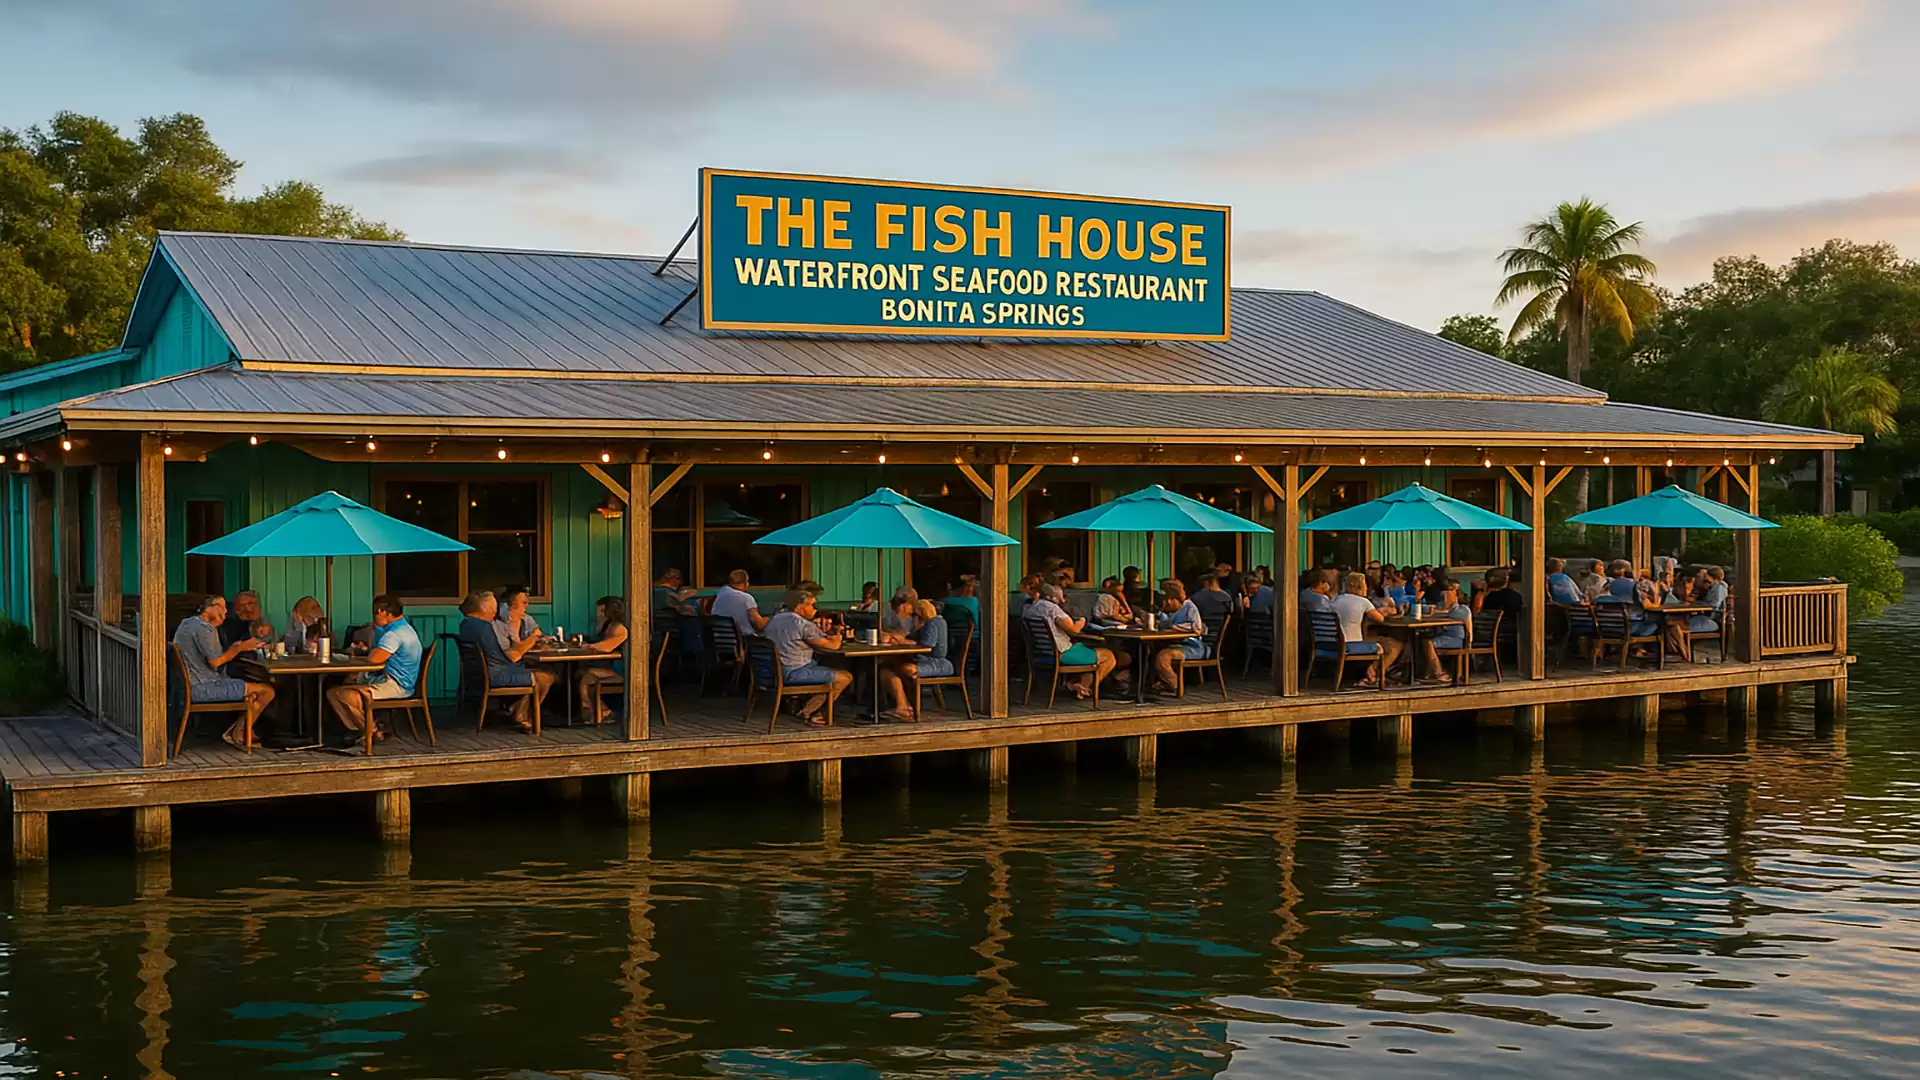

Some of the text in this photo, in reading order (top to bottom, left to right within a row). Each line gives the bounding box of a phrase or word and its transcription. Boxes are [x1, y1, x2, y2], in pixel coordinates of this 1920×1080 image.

[736, 195, 1207, 266] THE FISH HOUSE
[734, 257, 1208, 303] WATERFRONT SEAFOOD RESTAURANT
[881, 298, 1085, 326] BONITA SPRINGS
